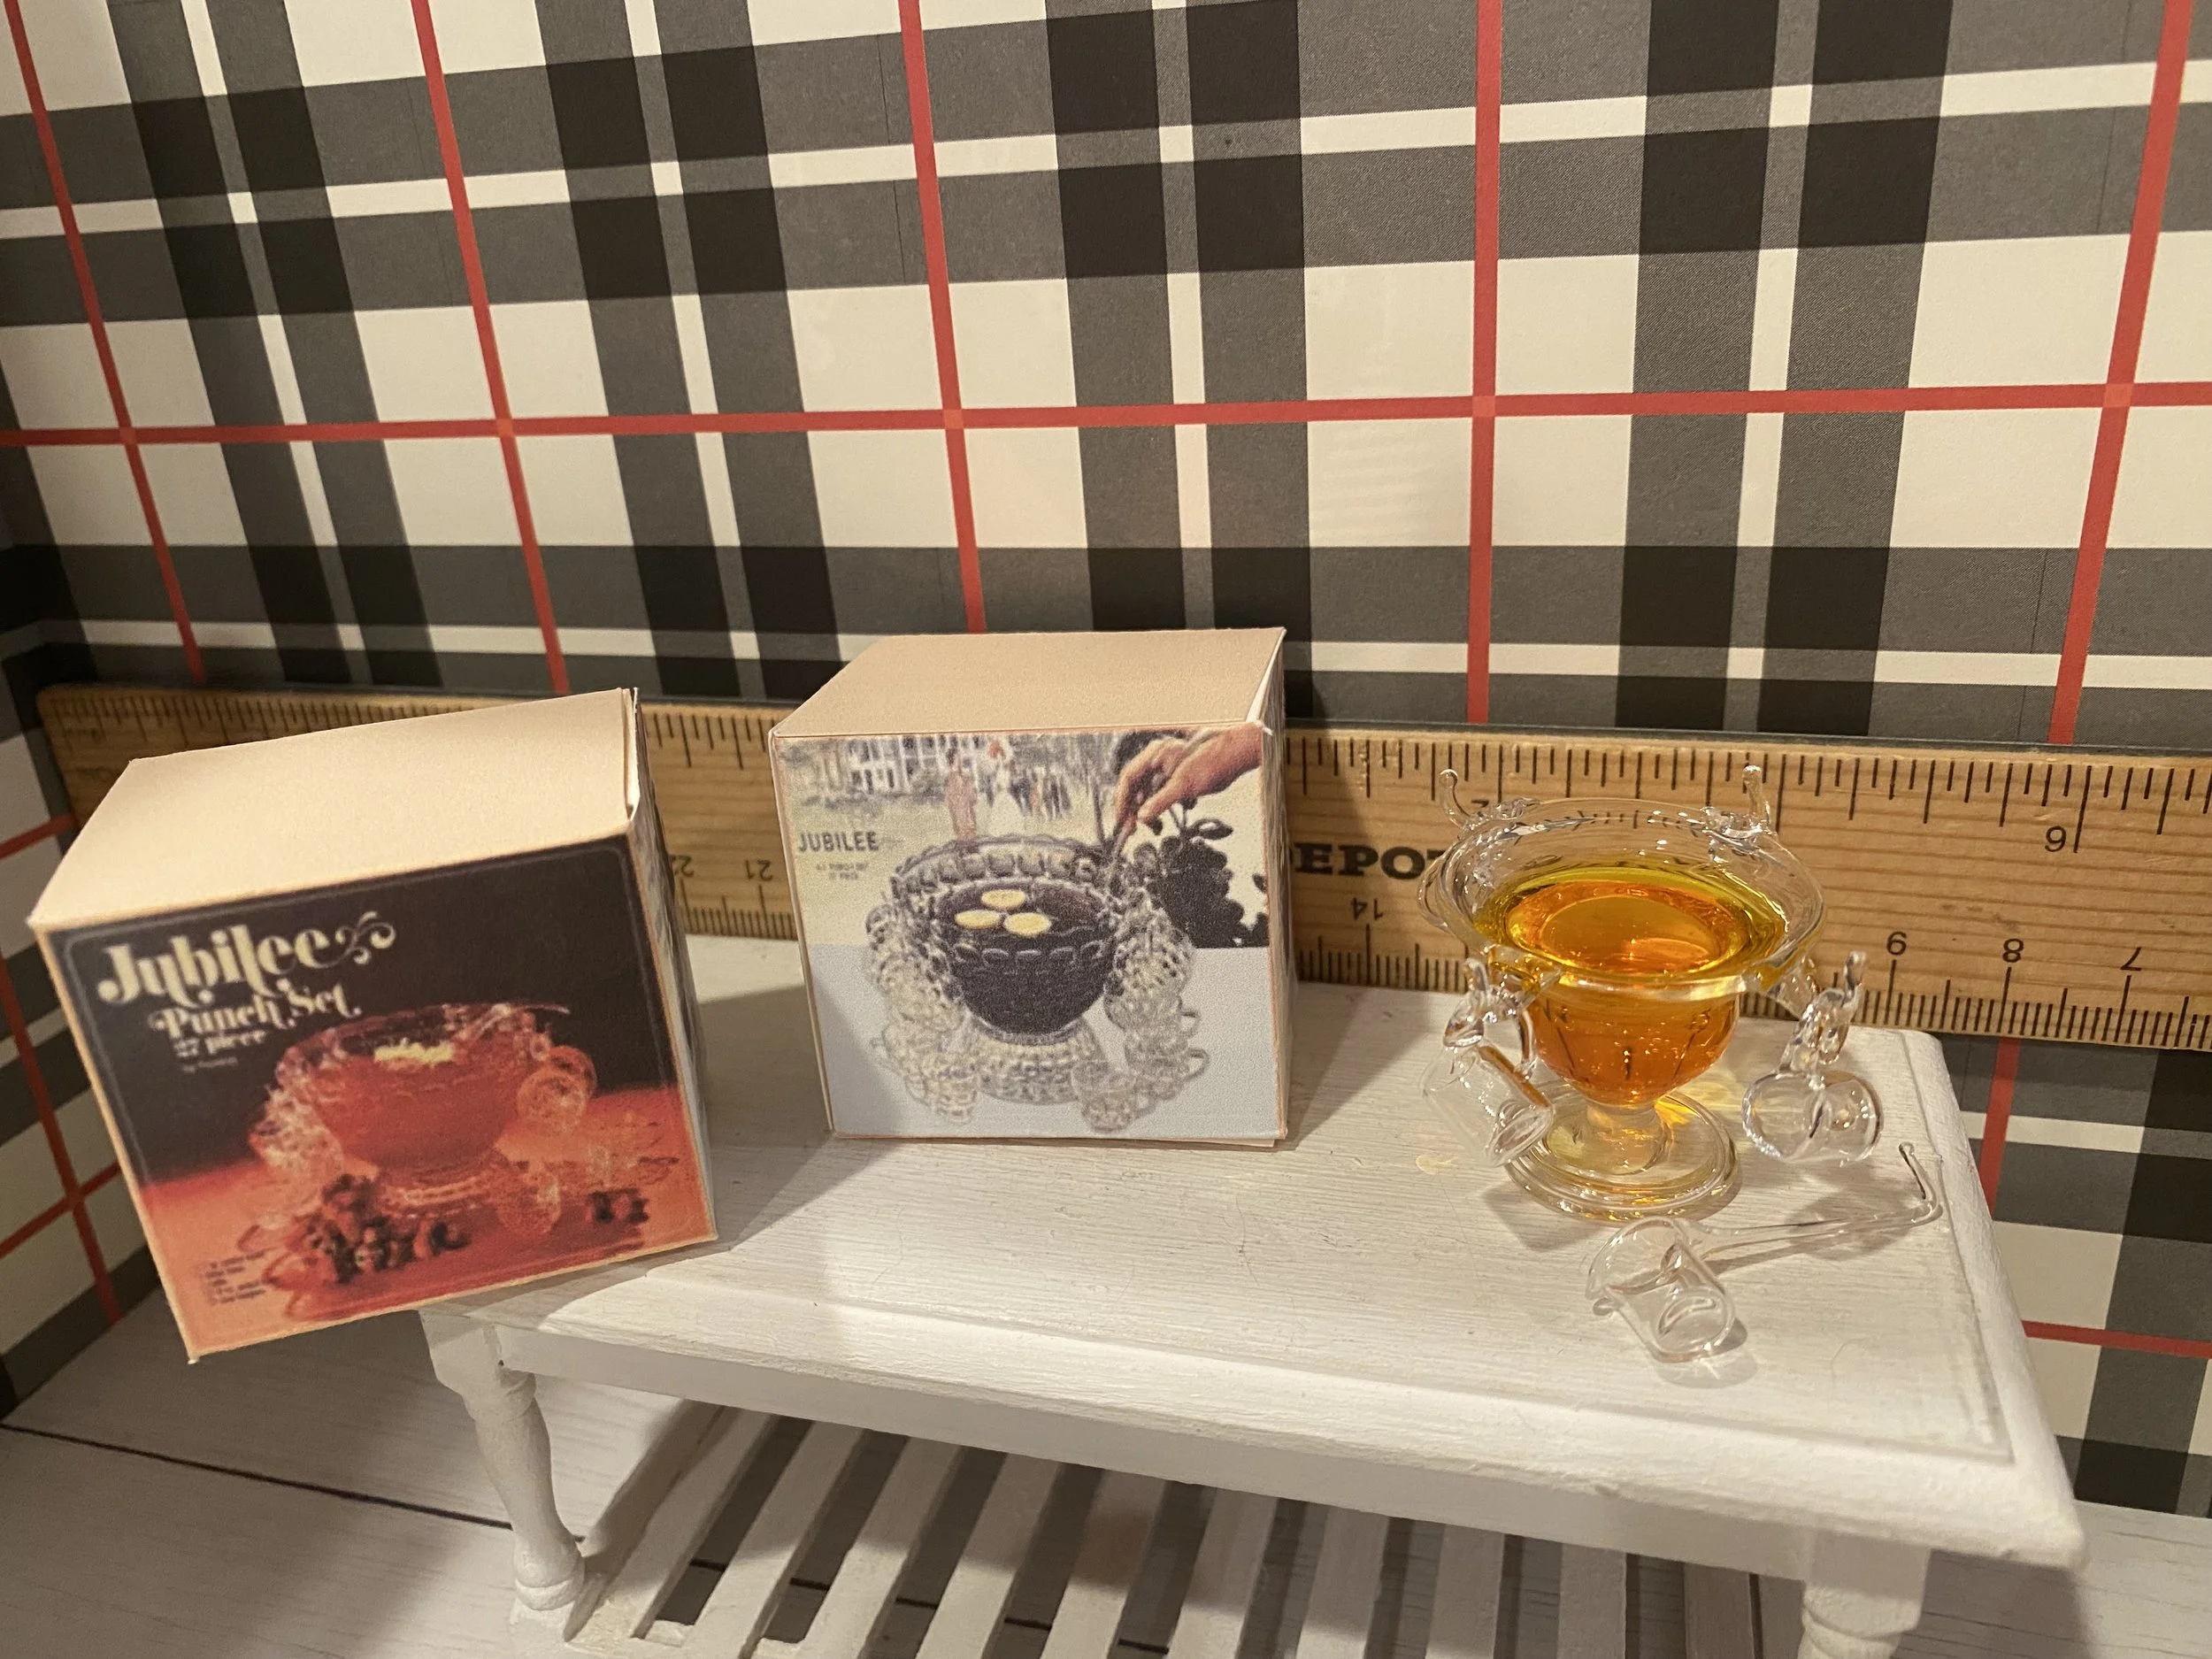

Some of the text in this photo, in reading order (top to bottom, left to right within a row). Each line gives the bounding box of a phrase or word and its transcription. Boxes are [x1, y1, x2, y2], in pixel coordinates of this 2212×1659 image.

[799, 831, 879, 851] JUBILEE
[744, 858, 773, 881] 21
[1288, 841, 1447, 880] EPO
[1350, 896, 1384, 921] 14
[96, 911, 395, 1009] Jubilee
[2001, 938, 2025, 964] 8
[2120, 946, 2142, 972] 7
[149, 981, 362, 1039] Punch Set
